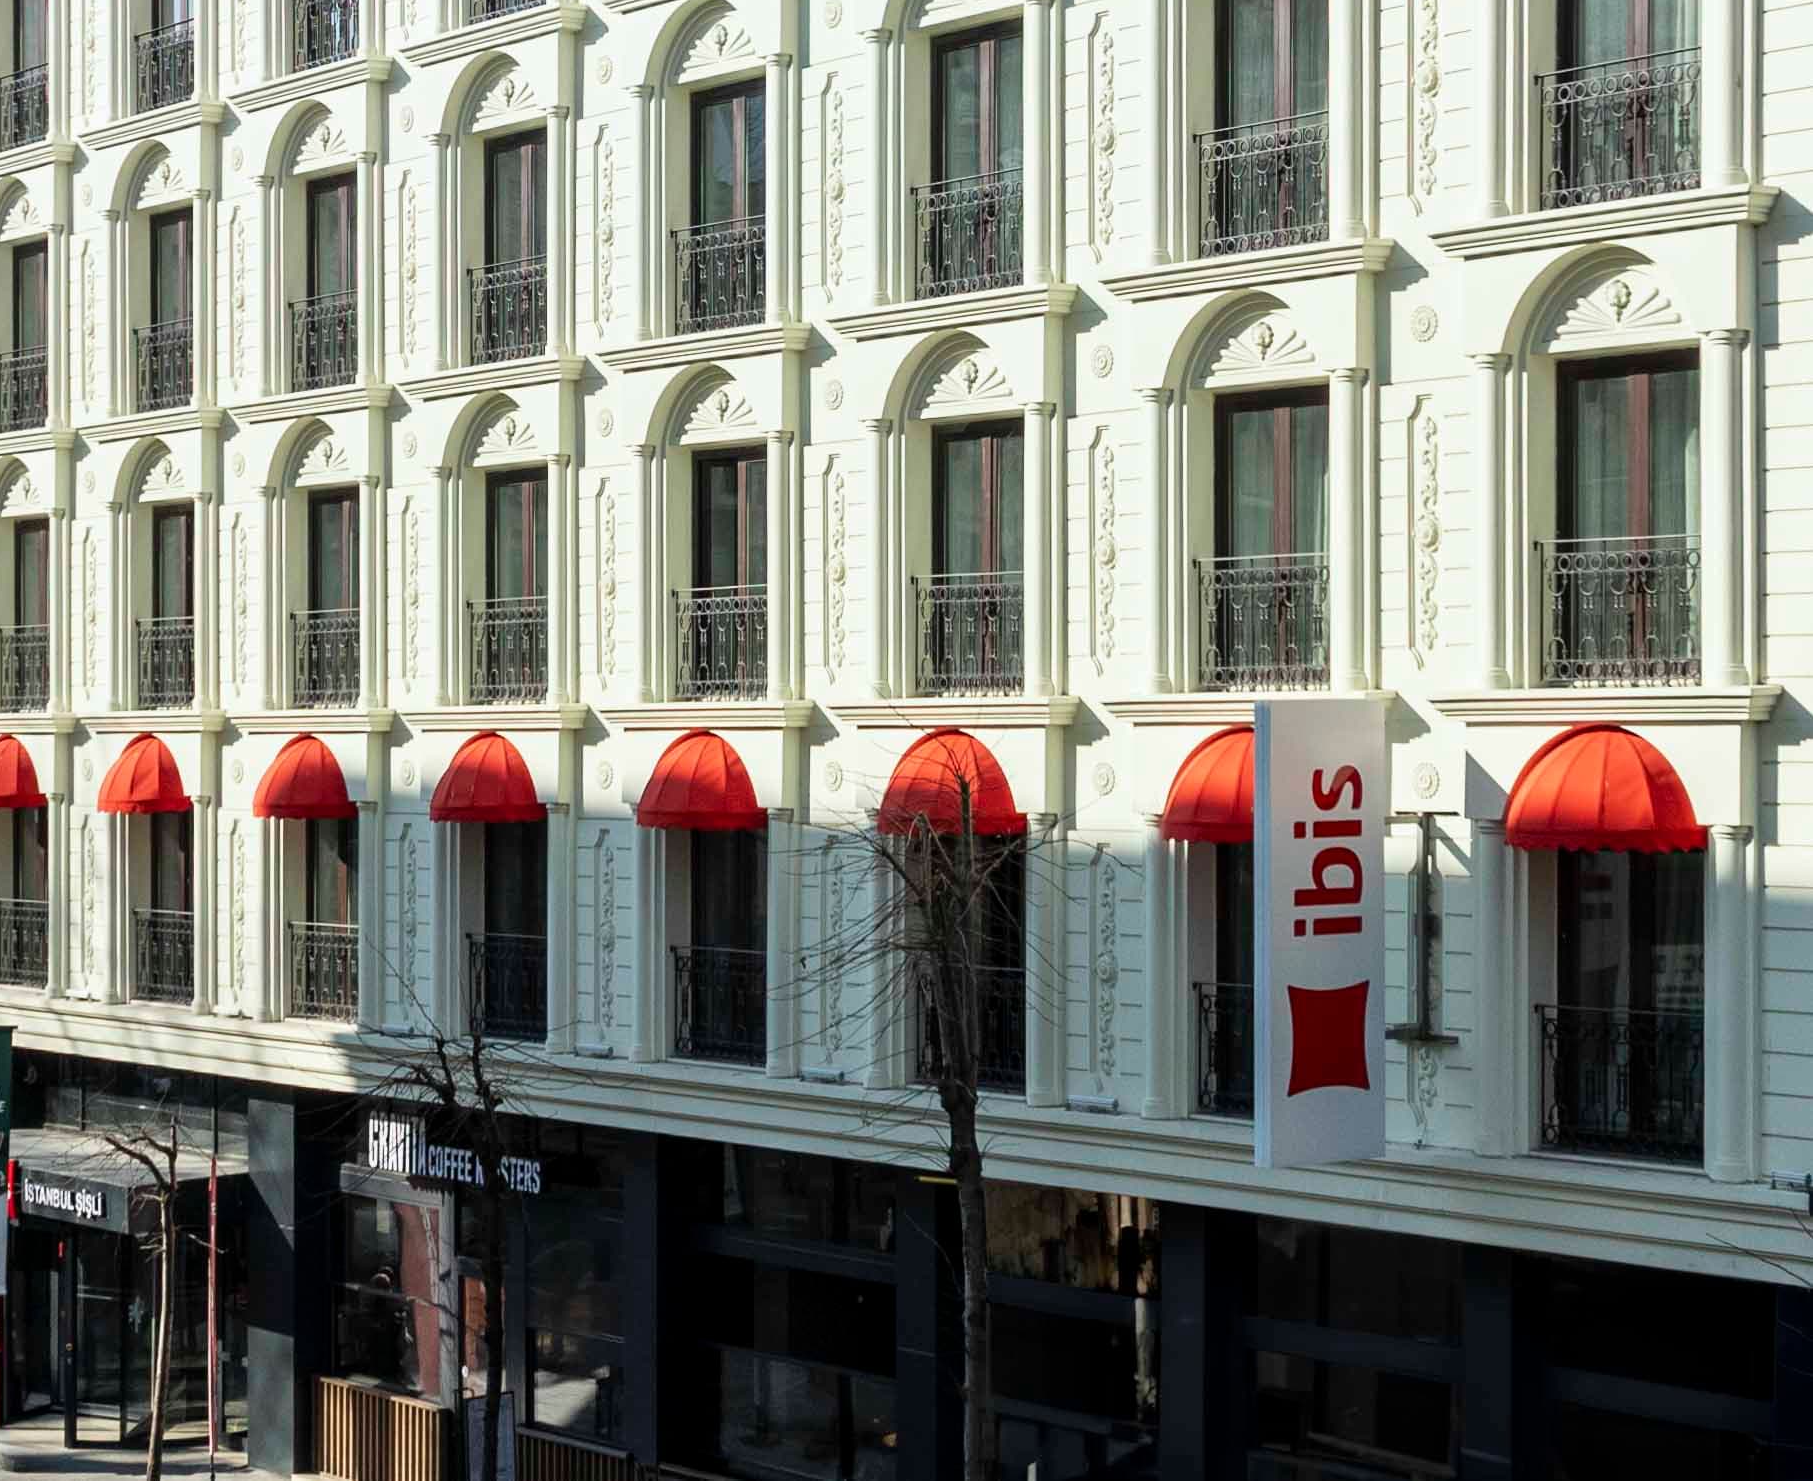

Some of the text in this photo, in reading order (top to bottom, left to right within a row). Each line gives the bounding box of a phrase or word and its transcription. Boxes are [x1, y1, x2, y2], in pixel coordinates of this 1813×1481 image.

[1293, 765, 1363, 937] ibis
[427, 1144, 474, 1183] COFFEE
[24, 1177, 75, 1212] İSTANBUL
[75, 1187, 103, 1220] ŞİŞLİ
